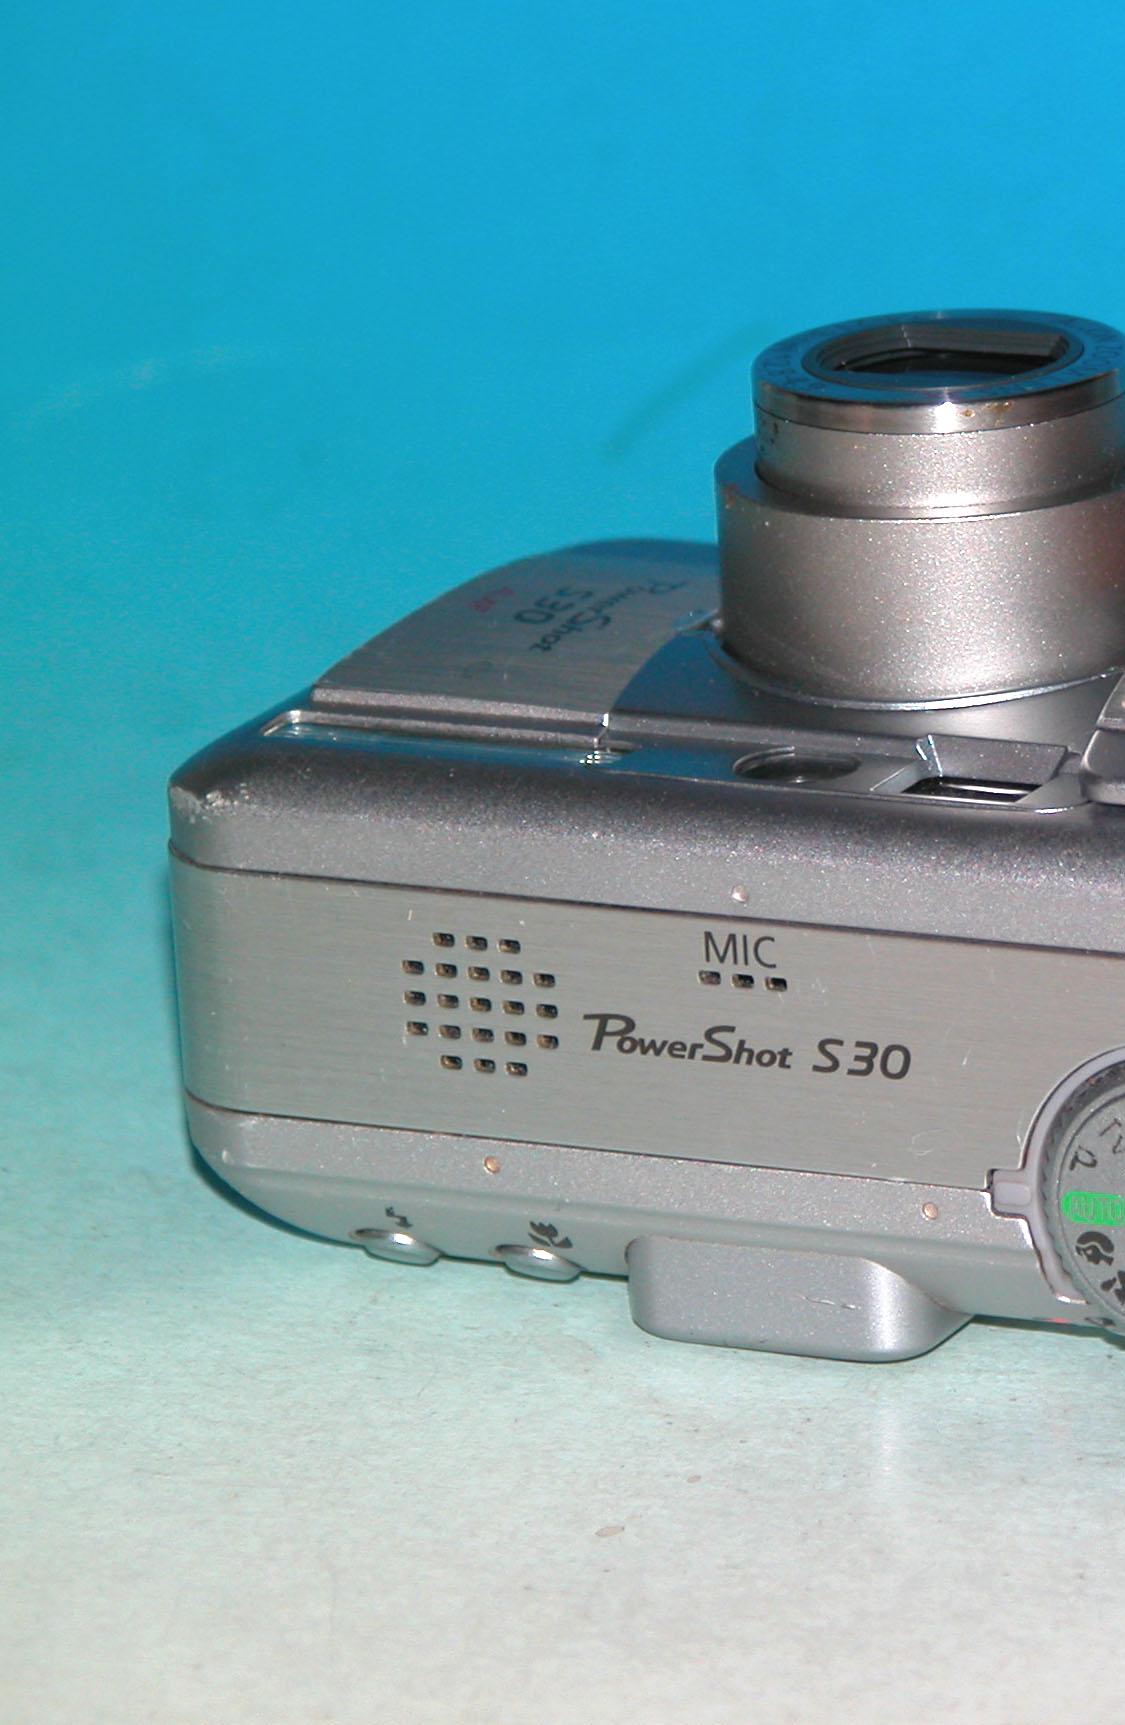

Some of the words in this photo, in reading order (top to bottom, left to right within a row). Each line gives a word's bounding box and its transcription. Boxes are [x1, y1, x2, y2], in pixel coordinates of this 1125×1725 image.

[513, 586, 594, 626] S30
[704, 930, 778, 969] MIC
[582, 1012, 794, 1070] PowerShot
[812, 1037, 912, 1081] S30
[1069, 1144, 1099, 1172] P
